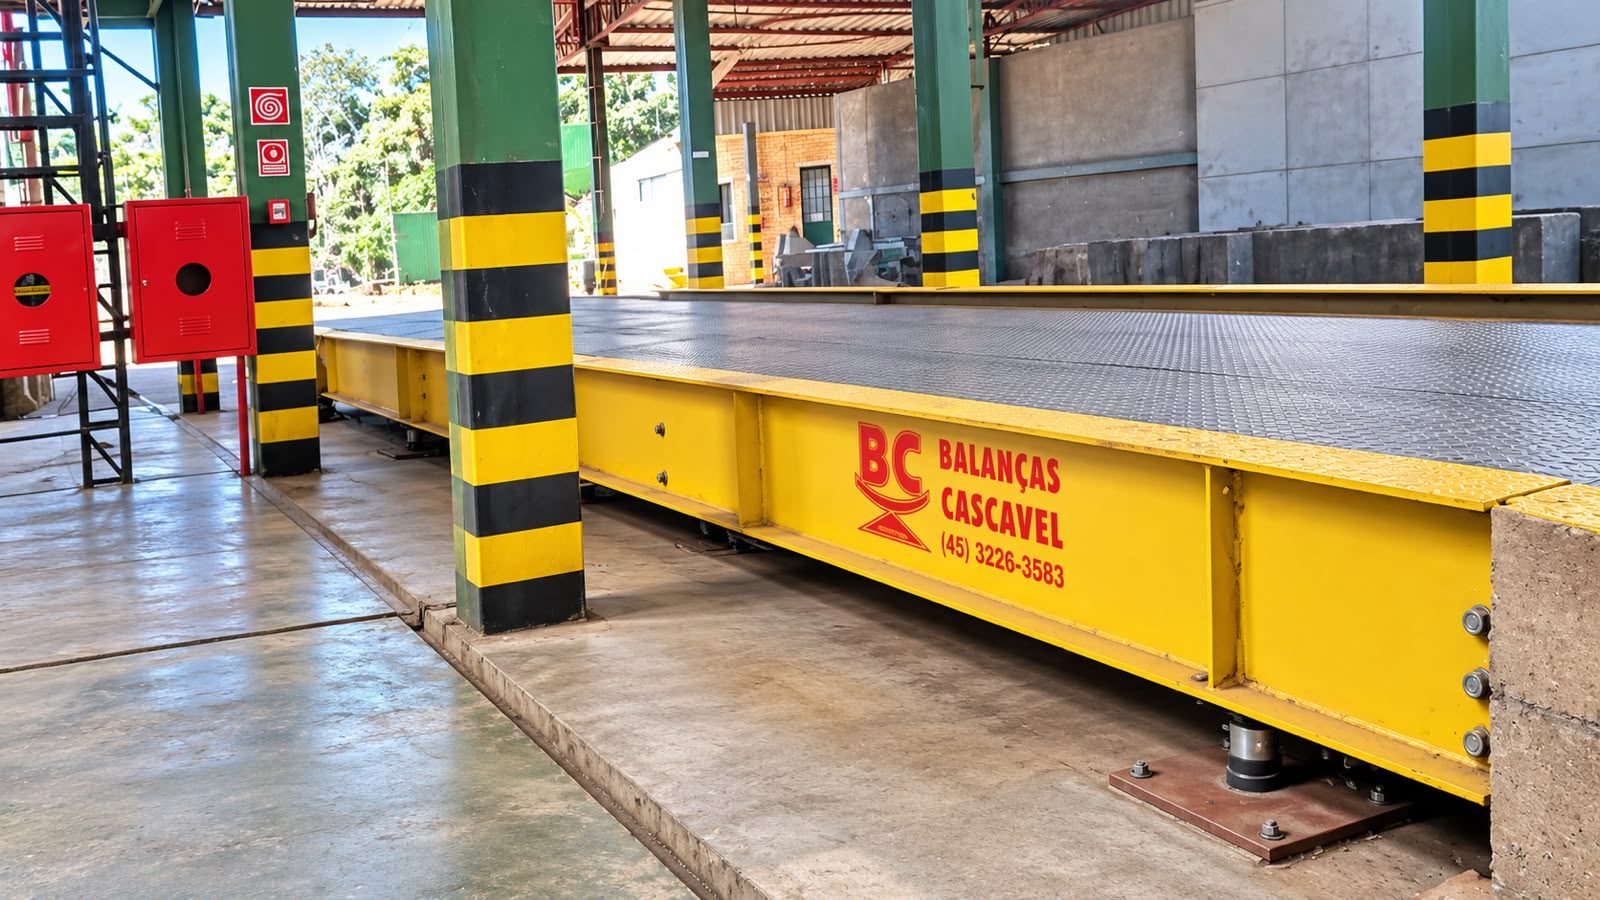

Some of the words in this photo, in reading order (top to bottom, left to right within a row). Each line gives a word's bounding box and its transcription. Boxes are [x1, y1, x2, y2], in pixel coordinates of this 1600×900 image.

[858, 421, 923, 496] BC
[938, 438, 1061, 493] BALANÇAS
[941, 486, 1063, 549] CASCAVEL
[941, 531, 970, 564] (45)
[975, 541, 1065, 589] 3226-3583
